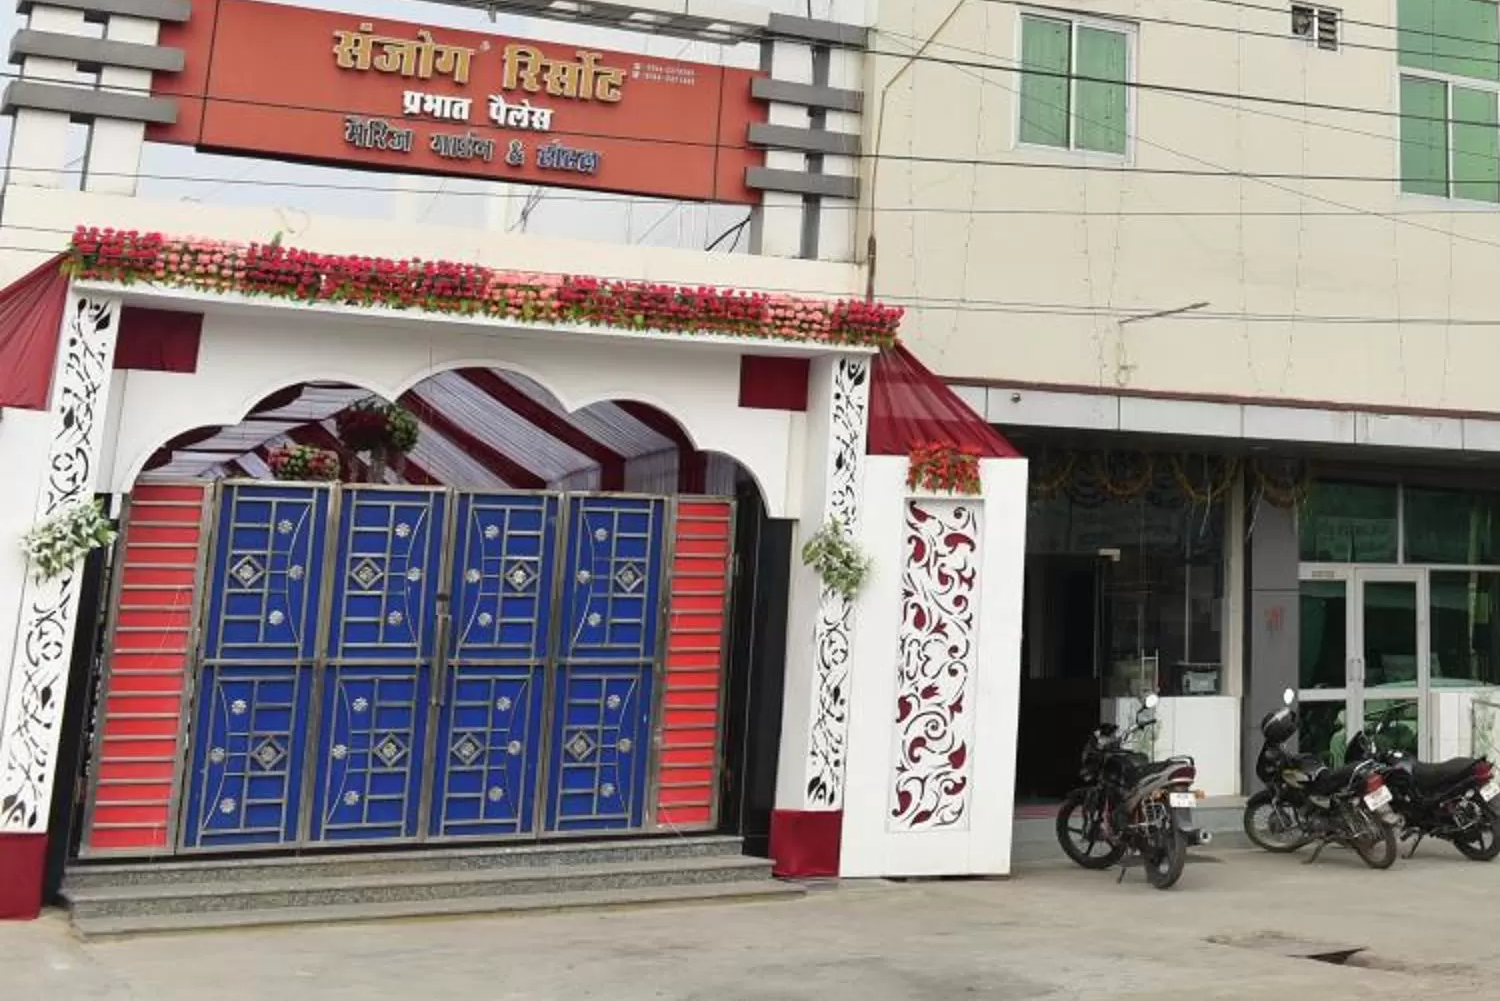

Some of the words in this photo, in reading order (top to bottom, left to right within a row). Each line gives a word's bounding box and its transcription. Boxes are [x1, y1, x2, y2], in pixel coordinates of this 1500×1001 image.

[332, 23, 476, 85] संजोग
[403, 90, 472, 121] प्रभात
[505, 139, 525, 166] &
